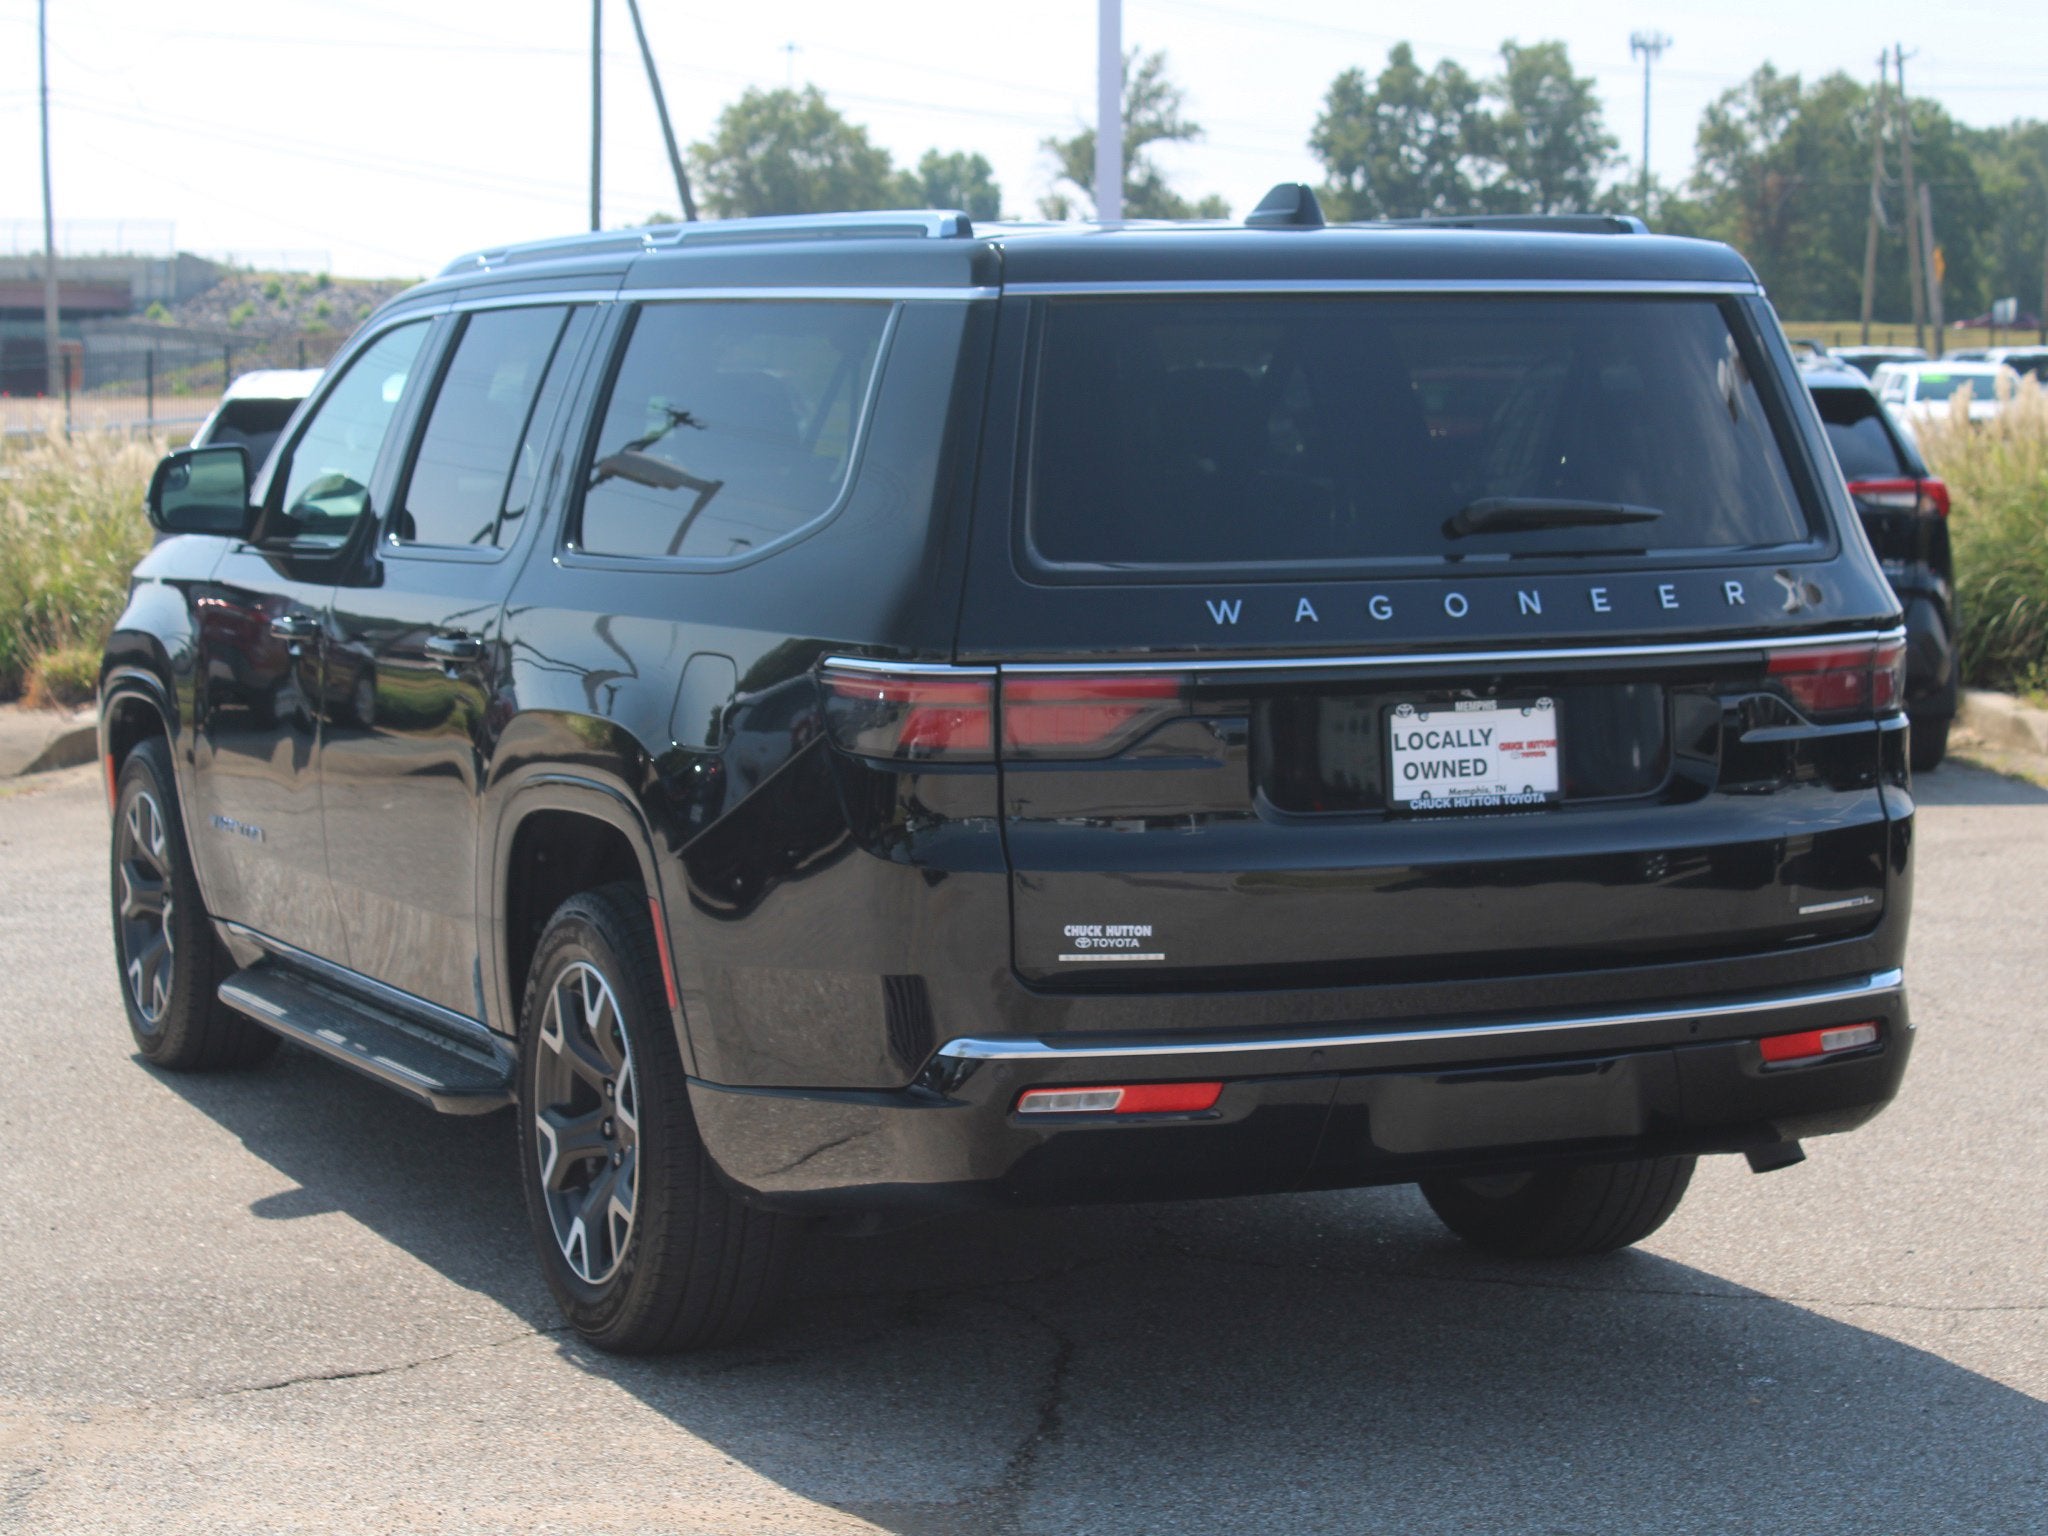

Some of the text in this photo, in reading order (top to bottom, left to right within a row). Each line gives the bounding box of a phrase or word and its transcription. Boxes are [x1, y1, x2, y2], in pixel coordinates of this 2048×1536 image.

[1206, 580, 1746, 626] WAGONEER
[1455, 700, 1498, 712] MEMPHIS
[1394, 728, 1493, 751] LOCALLY
[1403, 758, 1488, 780] OWNED
[1495, 785, 1507, 793] TN
[1410, 793, 1546, 810] CHUCK HUTTON TOYOTA
[1064, 925, 1152, 936] CHUCK HUTTON
[1092, 938, 1140, 948] TOYOTA
